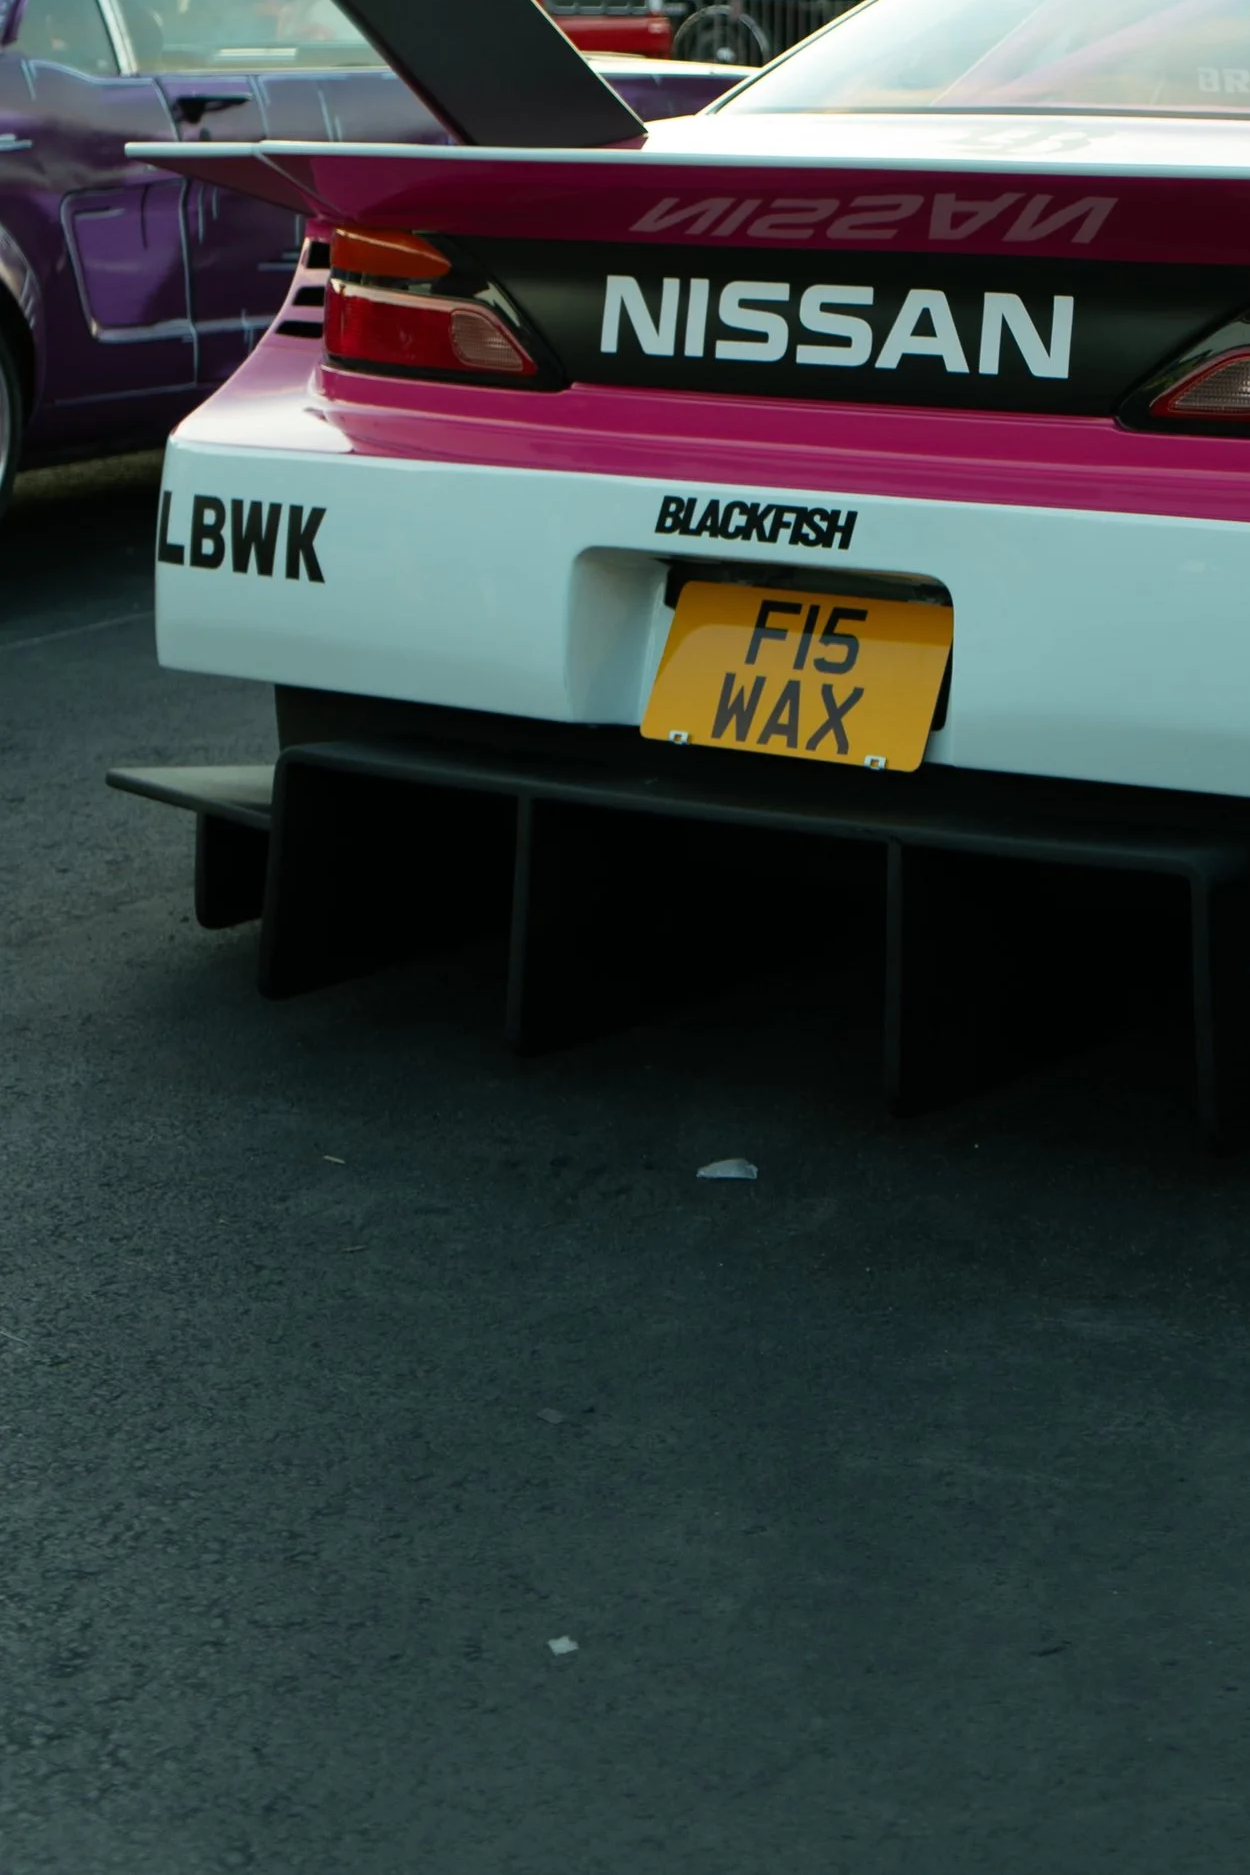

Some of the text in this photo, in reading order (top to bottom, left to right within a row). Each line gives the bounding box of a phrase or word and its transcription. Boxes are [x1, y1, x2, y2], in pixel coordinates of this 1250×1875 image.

[600, 274, 1074, 381] NISSAN
[157, 490, 327, 585] LBWK
[654, 495, 859, 551] BLACKFISH
[710, 672, 866, 757] WAX
